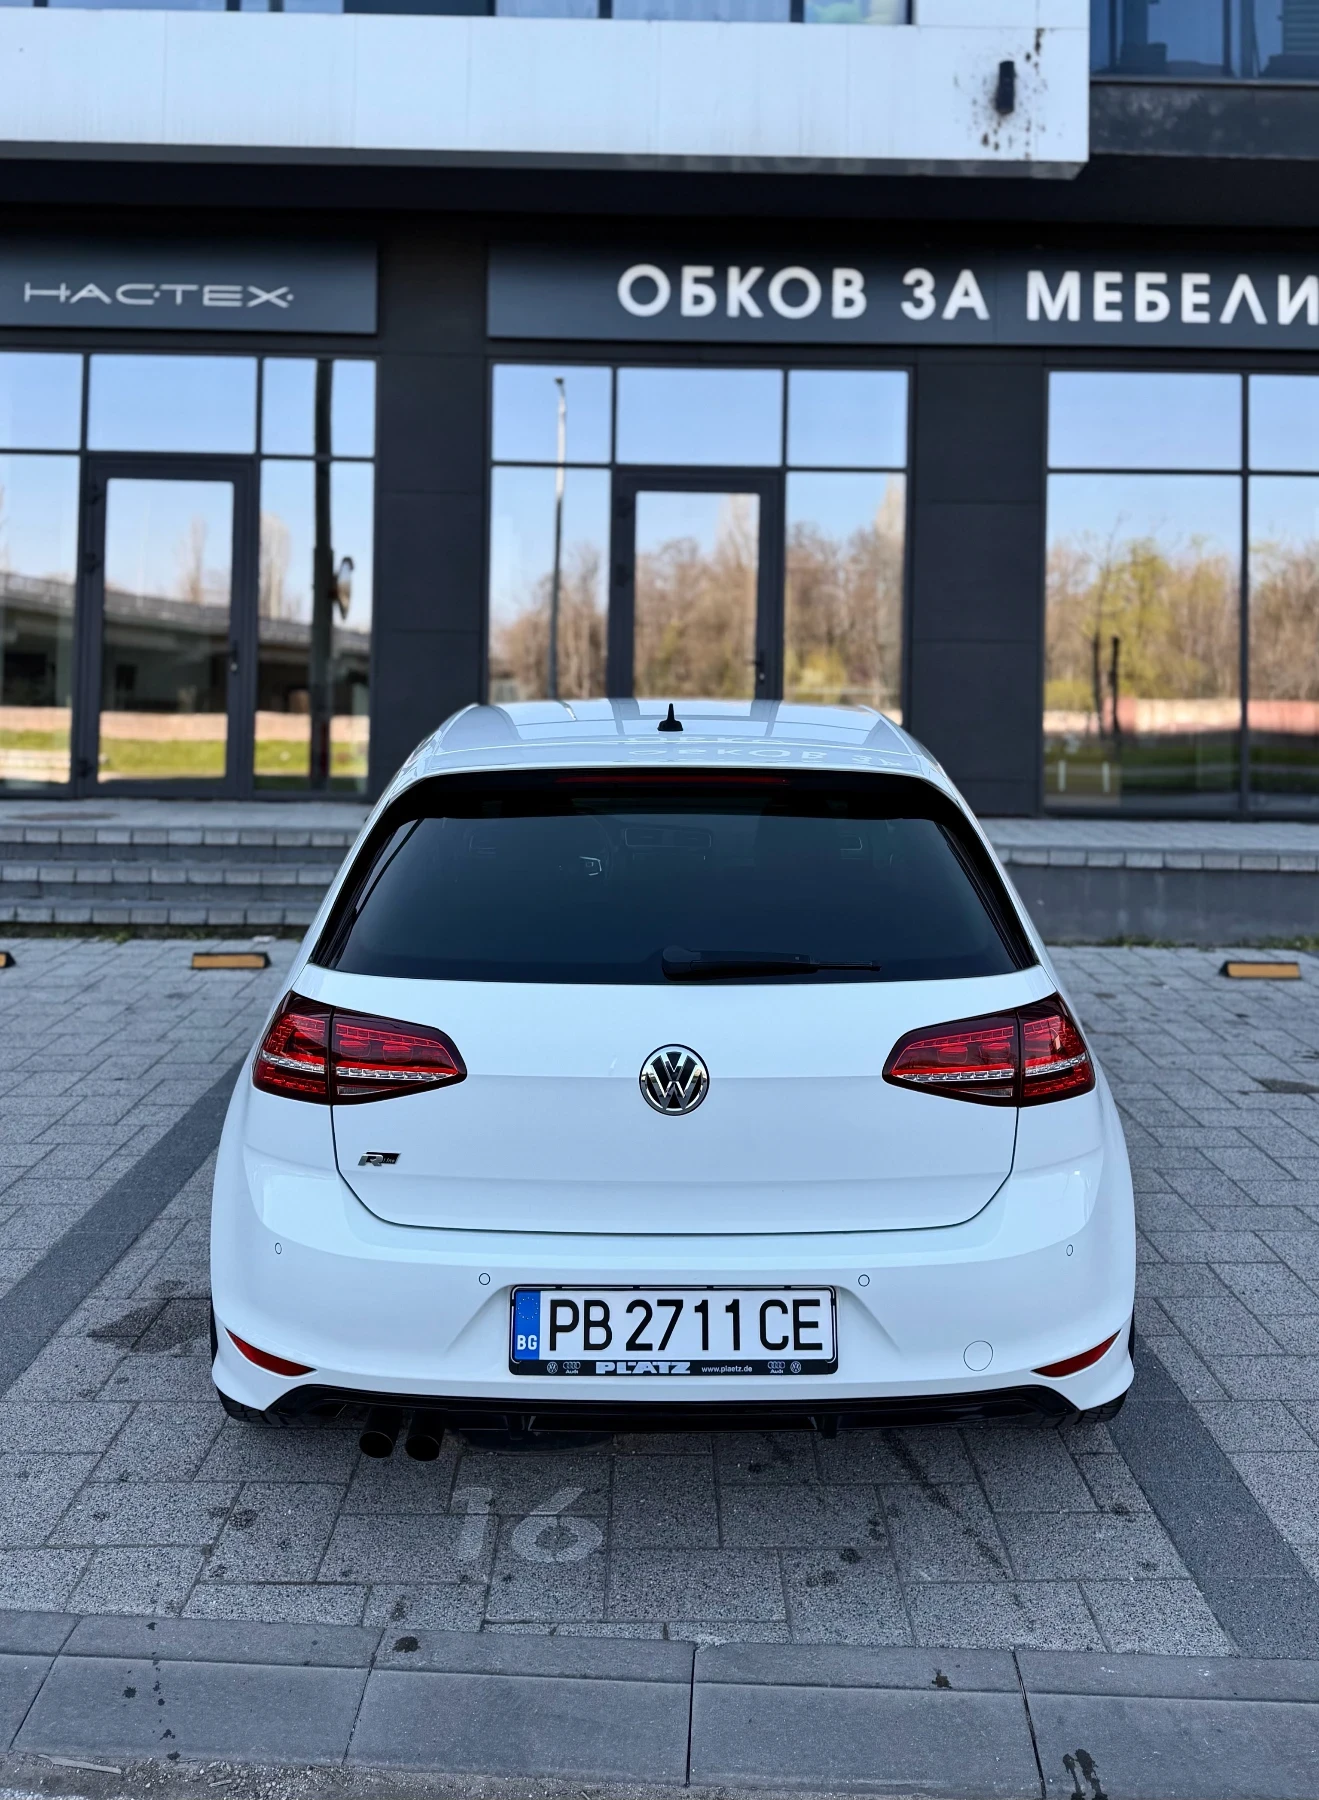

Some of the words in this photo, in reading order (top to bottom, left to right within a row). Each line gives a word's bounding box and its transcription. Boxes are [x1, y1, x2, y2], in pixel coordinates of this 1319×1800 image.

[617, 263, 867, 320] ОБКОВ
[901, 267, 991, 321] ЗА
[1026, 270, 1319, 326] МЕБЕЛИ
[516, 1334, 538, 1351] BG
[550, 1298, 613, 1352] PB
[625, 1298, 741, 1352] 2711
[759, 1298, 823, 1352] CE
[701, 1363, 753, 1374] www.plaetz.de
[452, 1487, 603, 1563] 16
